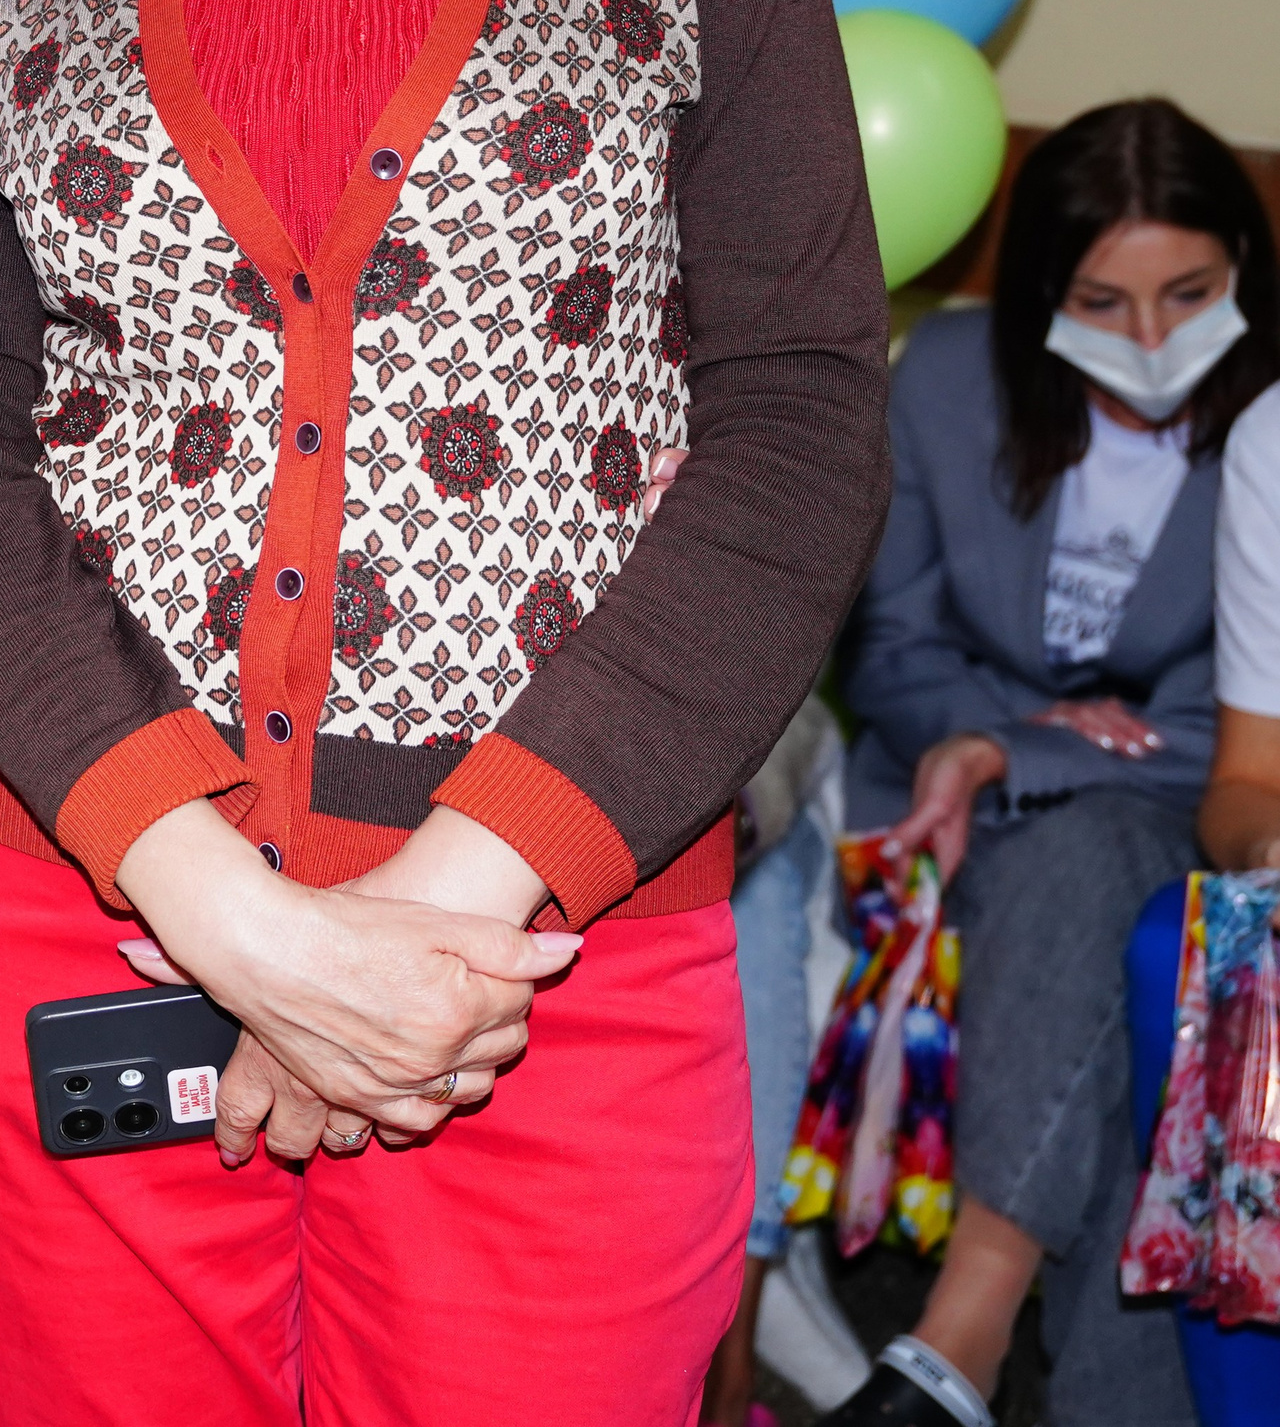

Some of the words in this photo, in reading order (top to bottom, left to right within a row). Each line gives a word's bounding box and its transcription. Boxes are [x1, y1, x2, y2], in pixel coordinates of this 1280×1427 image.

[177, 1078, 188, 1098] ОЧЕНЬ
[197, 1074, 209, 1095] СОБОЙ
[180, 1101, 190, 1115] ТЕБЕ
[201, 1096, 211, 1114] БЫТЬ
